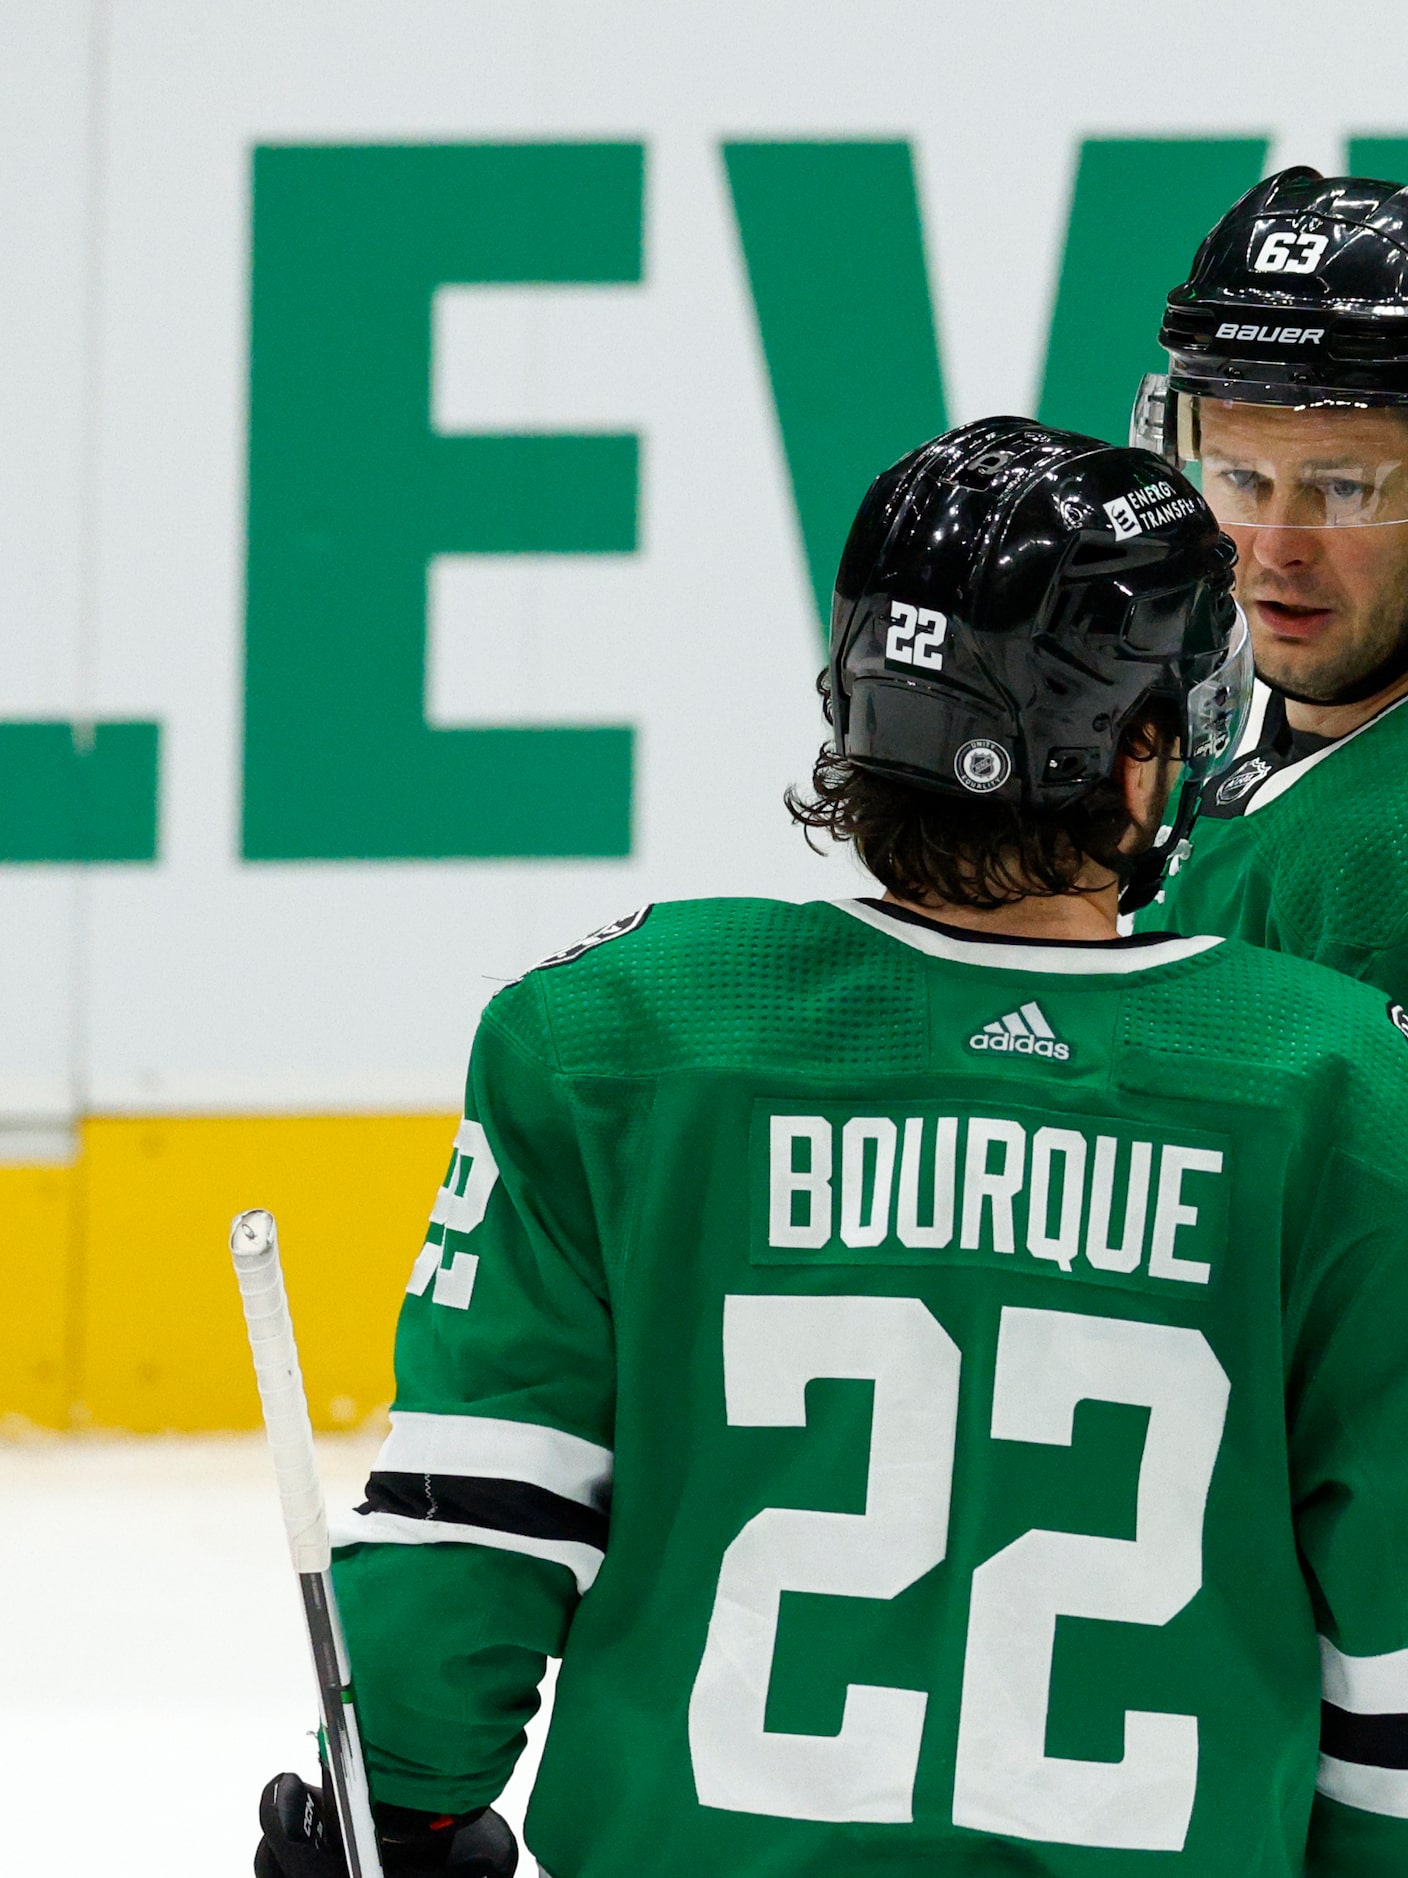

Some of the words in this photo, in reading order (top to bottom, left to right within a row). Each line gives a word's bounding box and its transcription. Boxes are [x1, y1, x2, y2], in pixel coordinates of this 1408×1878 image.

[1254, 232, 1329, 274] 63
[886, 600, 947, 671] 22
[969, 1031, 1071, 1061] adidas
[769, 1115, 1223, 1285] BOURQUE
[688, 1294, 1231, 1852] 22
